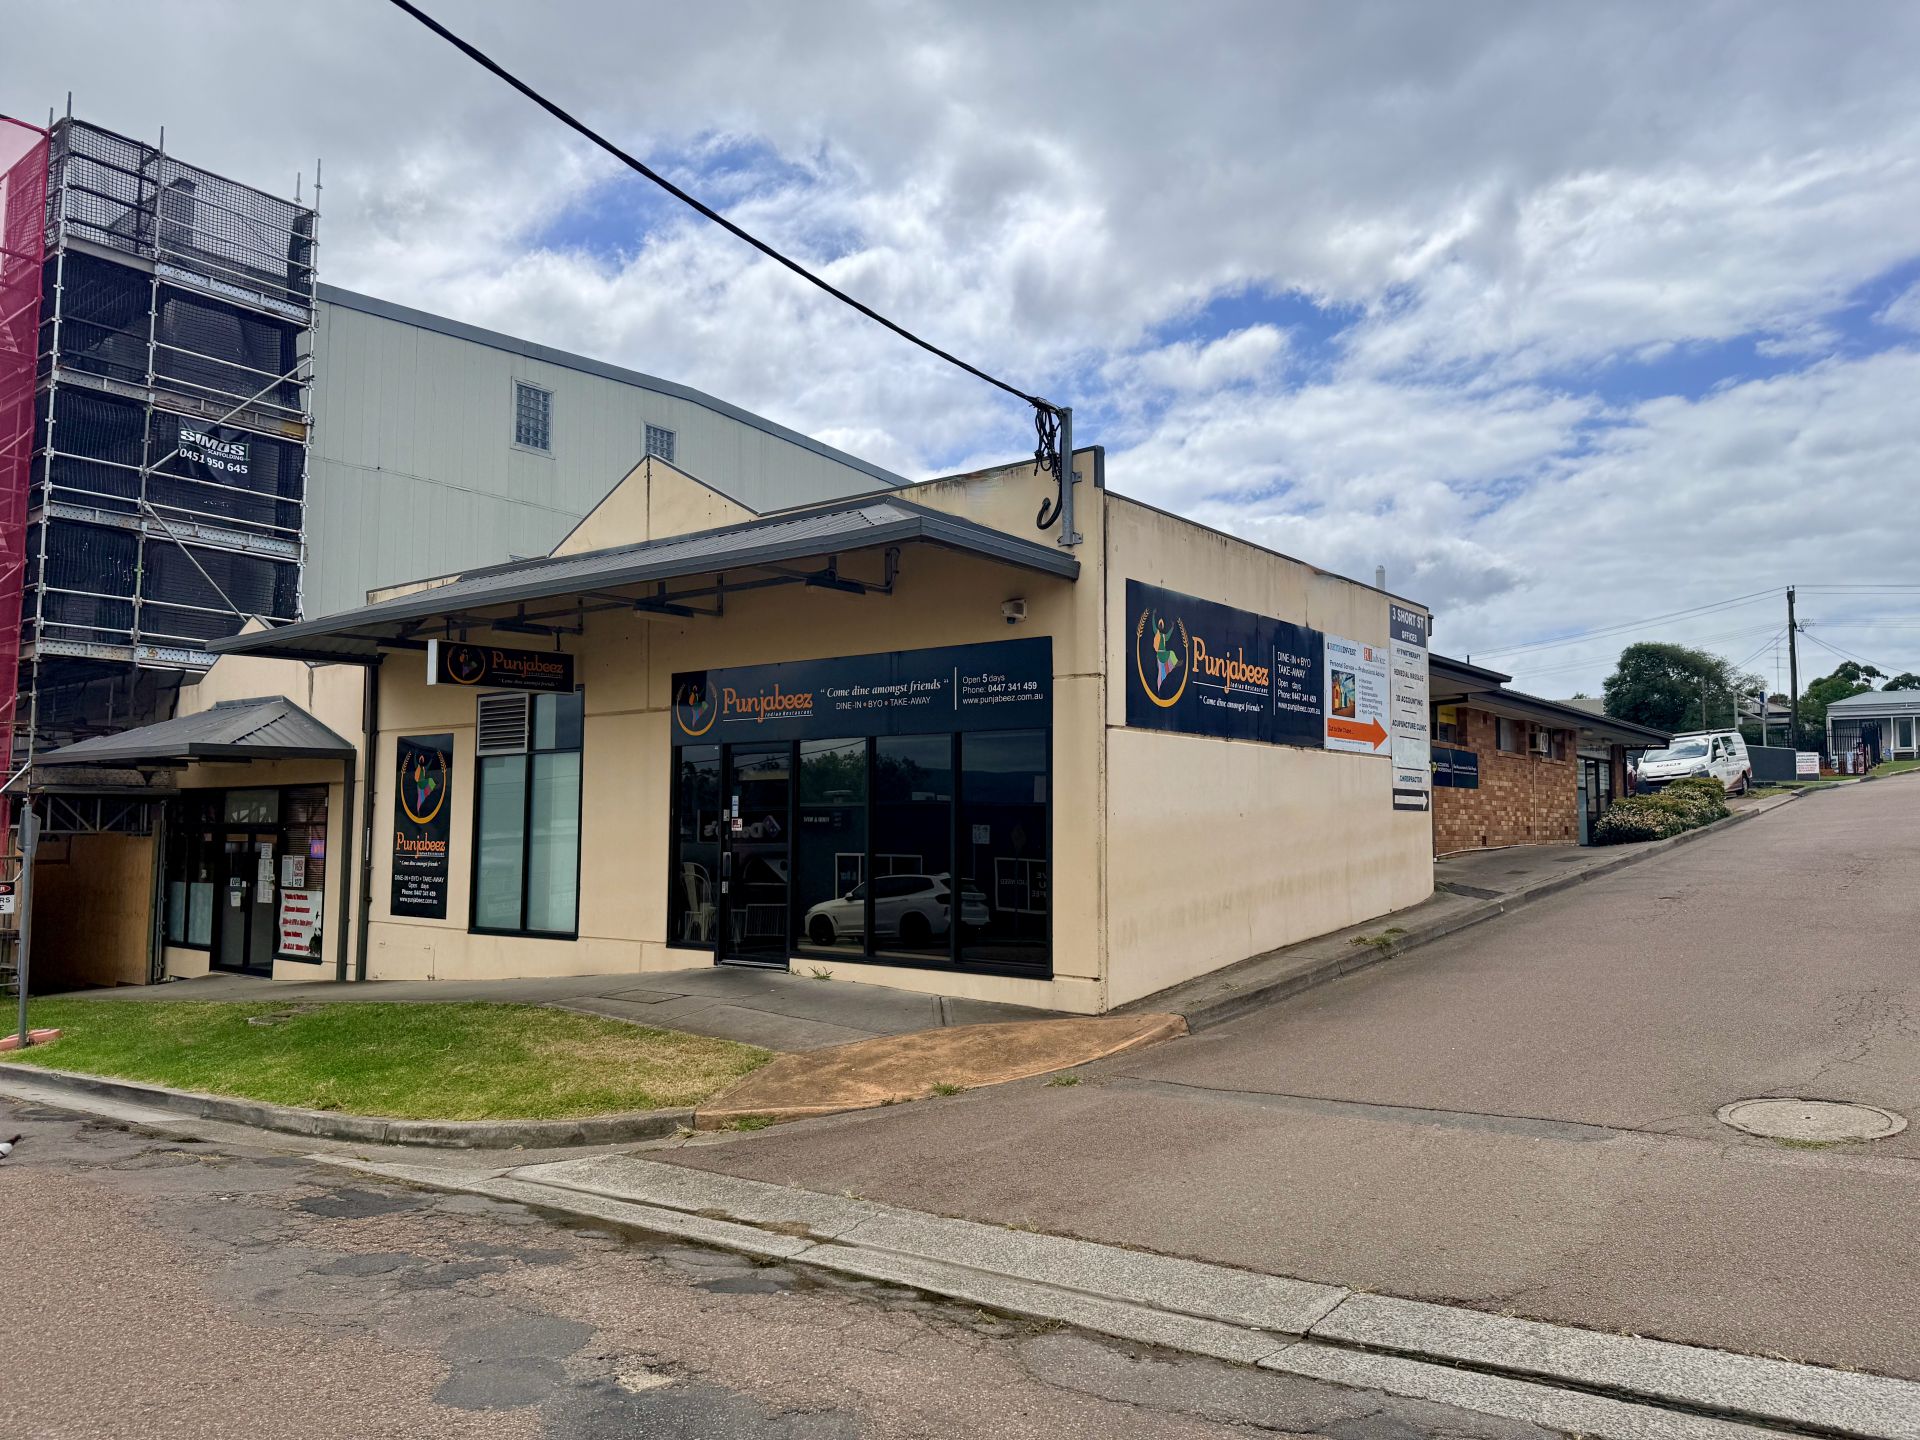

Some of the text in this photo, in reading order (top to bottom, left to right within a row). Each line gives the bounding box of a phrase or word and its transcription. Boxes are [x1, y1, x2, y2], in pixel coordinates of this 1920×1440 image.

[180, 448, 248, 474] 0451 950 645
[208, 449, 244, 461] SCAFFOLDING
[1392, 607, 1424, 630] 3 SHORT ST
[1401, 630, 1418, 643] OFFICES
[491, 651, 564, 678] Punjabeez
[1192, 636, 1269, 694] Punjabeez
[1277, 651, 1312, 668] DINE-IN BYO
[962, 673, 1005, 685] Open 5 days
[1277, 664, 1306, 679] TAKE-AWAY
[826, 687, 850, 698] Come
[851, 685, 870, 696] dine
[871, 683, 908, 695] amongst
[908, 678, 941, 694] friends
[962, 681, 1038, 694] Phone: 0447 341 459
[1277, 678, 1289, 688] Open
[722, 683, 813, 724] Punjabeez
[835, 696, 931, 710] DINE-IN BYO TAKE-AWAY
[962, 693, 1044, 705] www.punjabeez.com.au
[396, 832, 446, 859] Punjabeez
